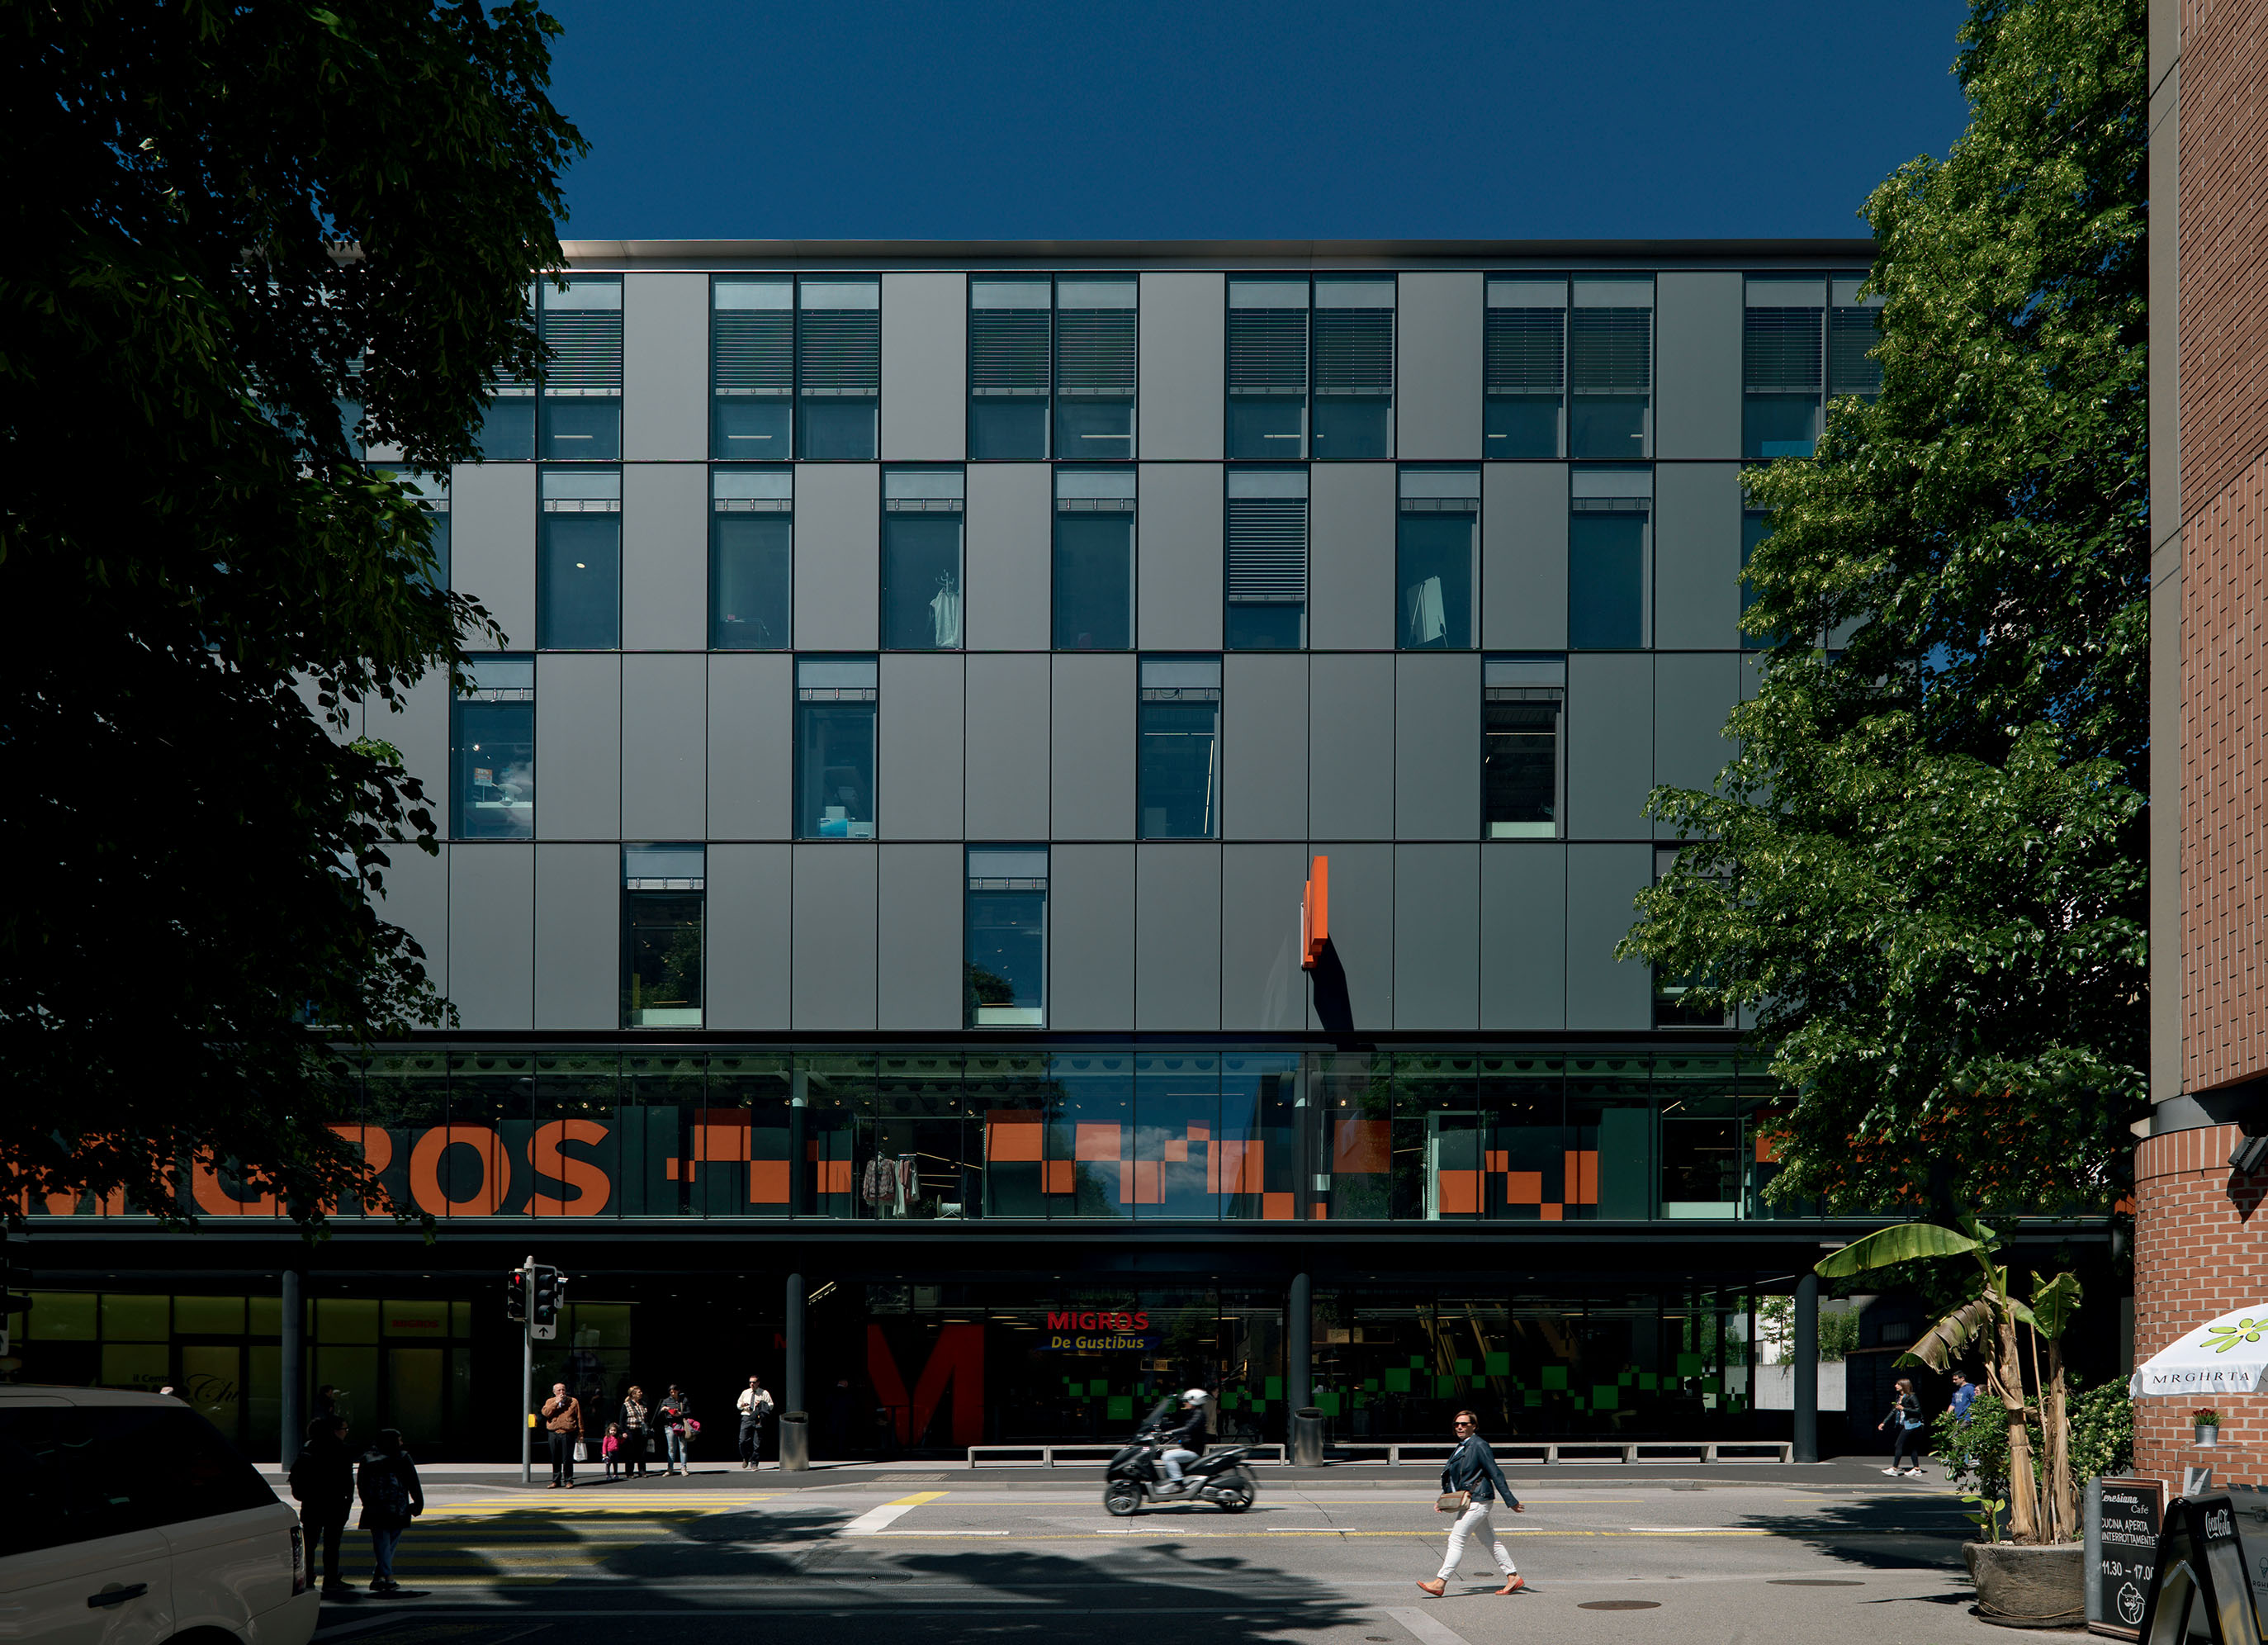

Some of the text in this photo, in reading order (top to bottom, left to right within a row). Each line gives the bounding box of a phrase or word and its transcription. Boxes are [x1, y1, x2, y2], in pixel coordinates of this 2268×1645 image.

[0, 1119, 611, 1216] GROS
[1047, 1311, 1149, 1330] MIGROS
[1052, 1335, 1144, 1349] De Gustibus
[2153, 1372, 2250, 1384] MRGHRTA
[2131, 1504, 2149, 1515] Café
[2124, 1519, 2150, 1534] APERTA
[2101, 1560, 2123, 1576] 11.30
